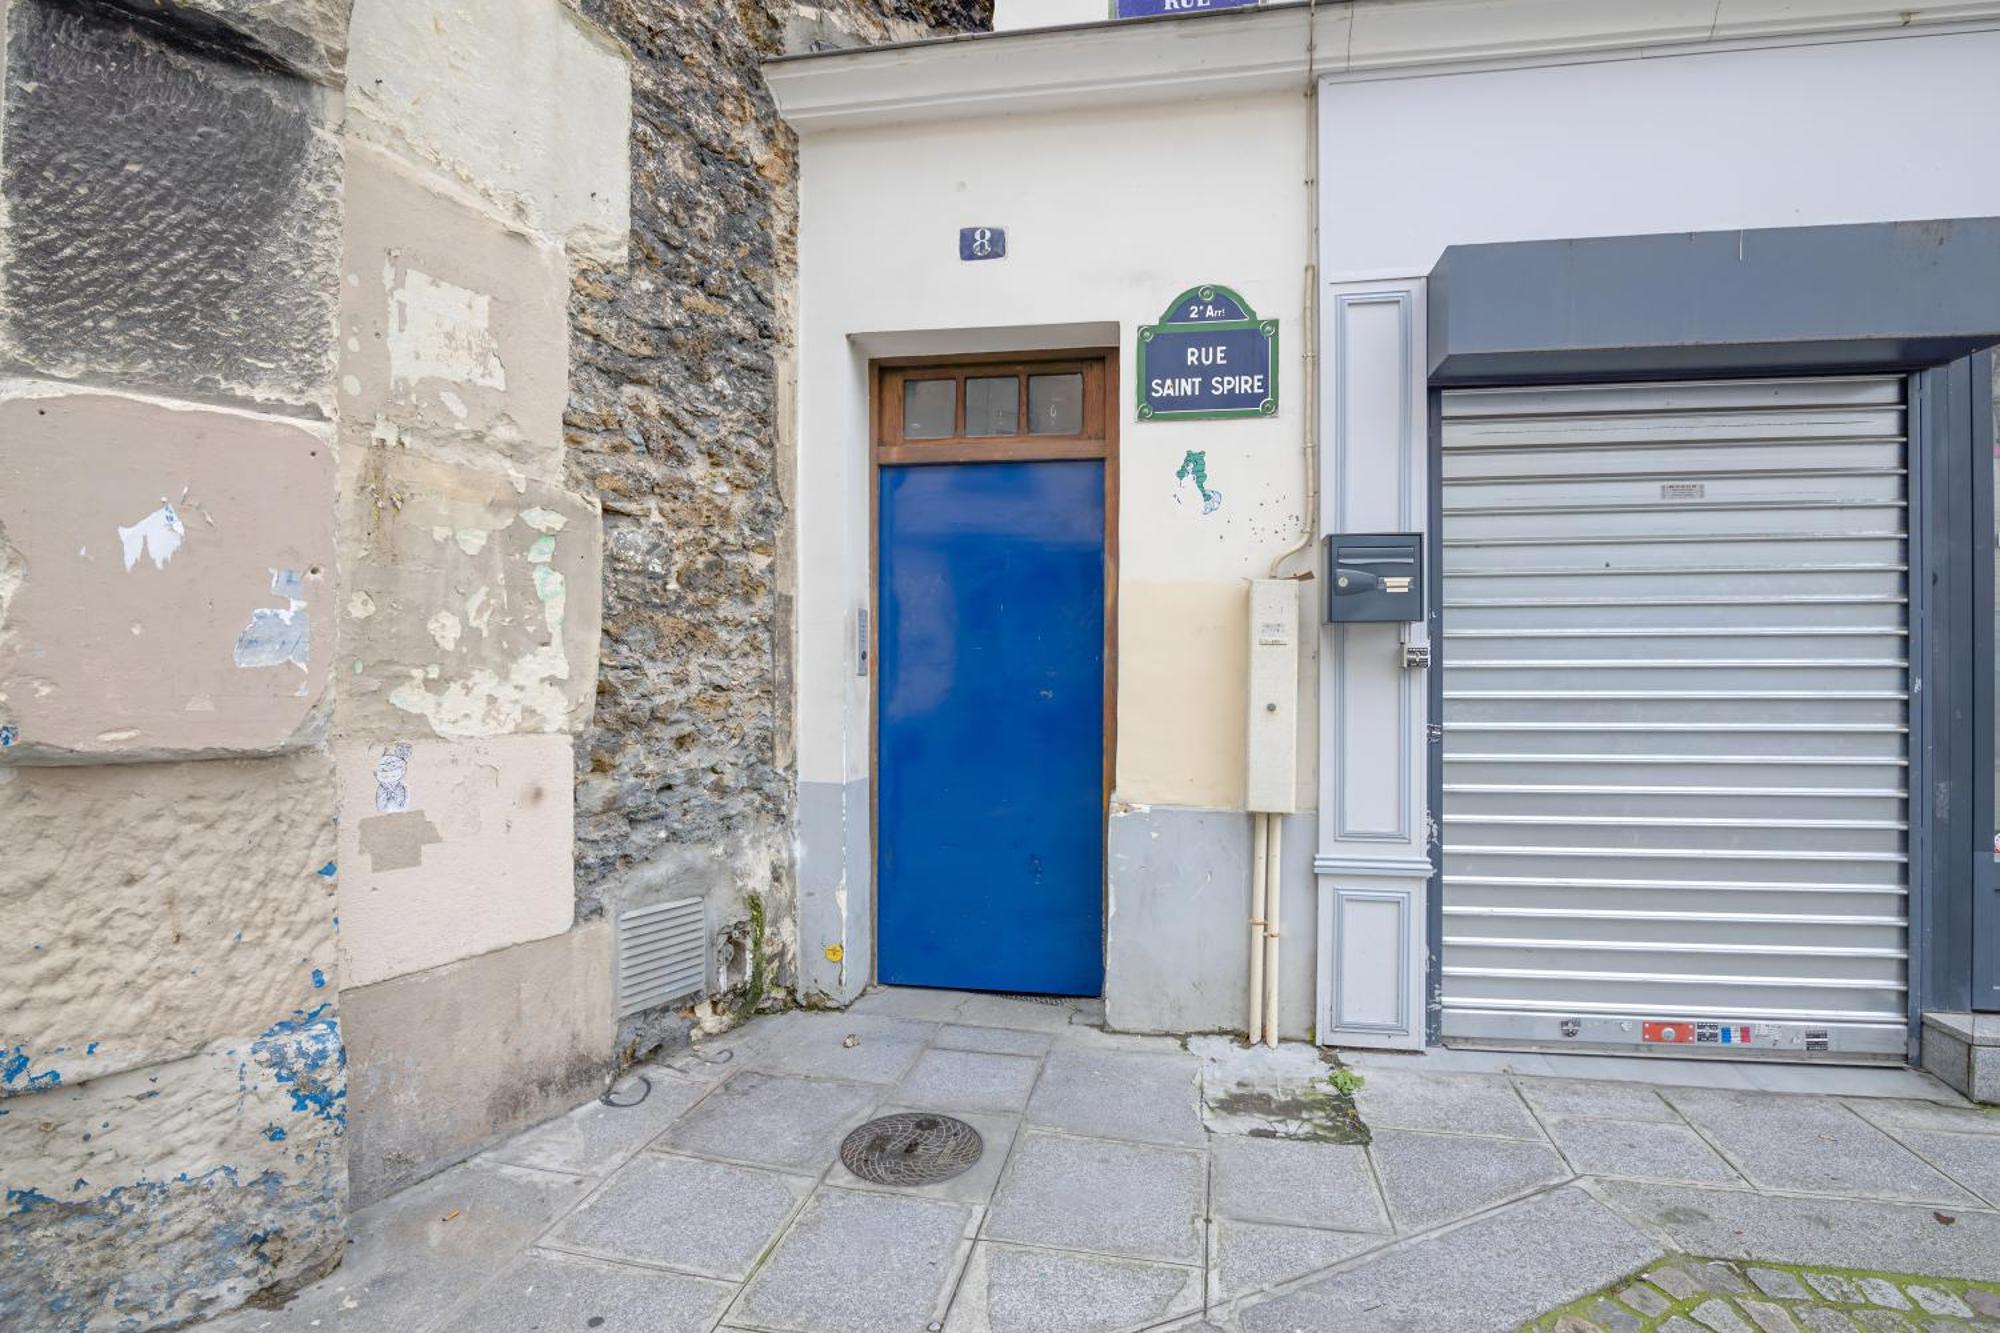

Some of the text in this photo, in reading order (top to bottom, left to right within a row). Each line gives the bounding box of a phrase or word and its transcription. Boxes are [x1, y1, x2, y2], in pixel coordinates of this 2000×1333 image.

[972, 228, 991, 256] 8
[1187, 346, 1227, 365] RUE
[1151, 375, 1264, 397] SAINT SPIRE
